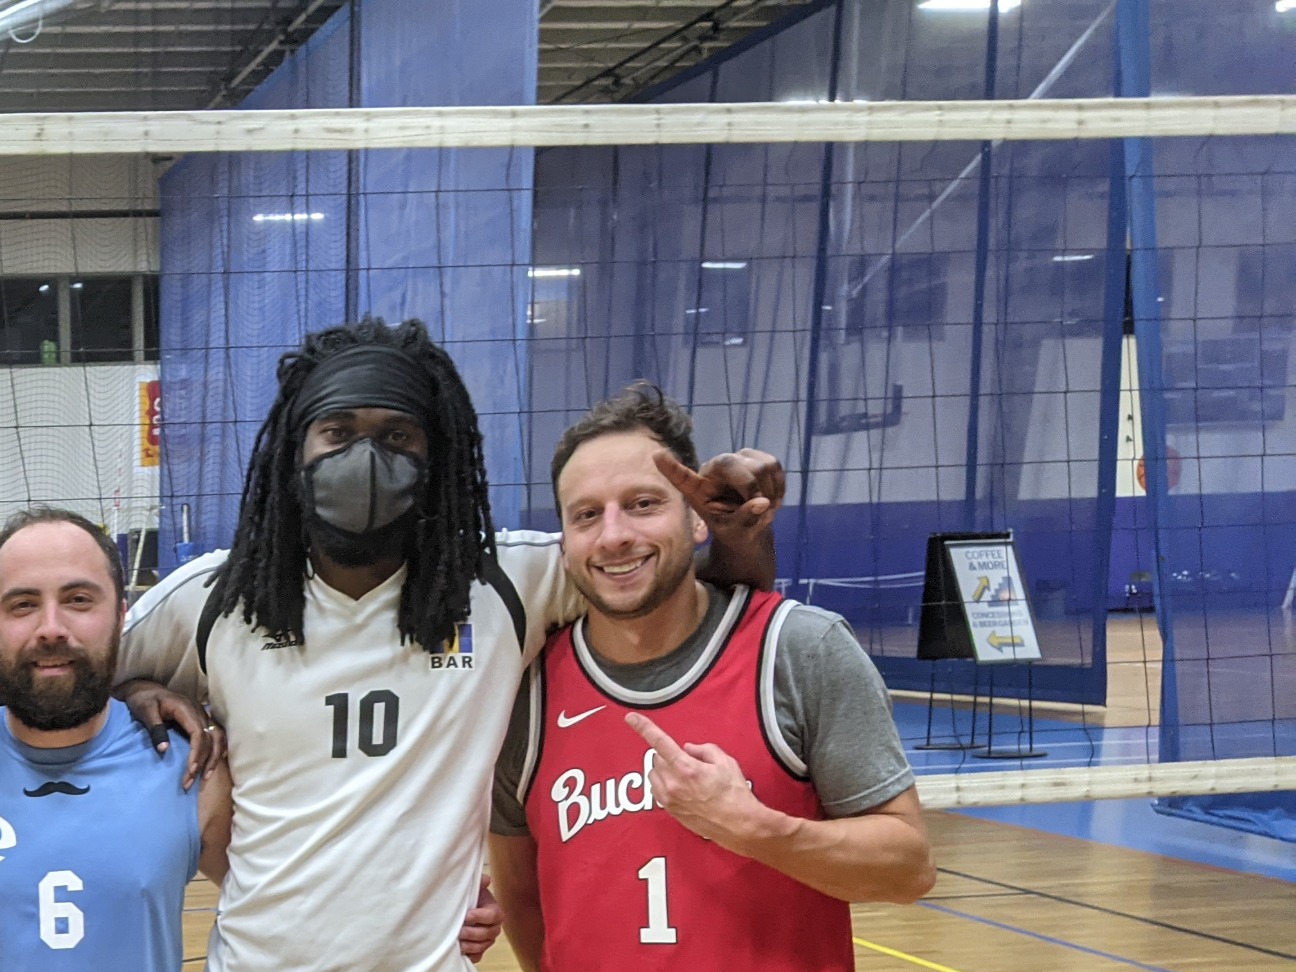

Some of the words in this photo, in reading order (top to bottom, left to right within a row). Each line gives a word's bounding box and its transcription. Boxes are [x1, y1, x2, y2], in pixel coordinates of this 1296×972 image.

[965, 550, 1004, 560] COFFEE
[978, 560, 1007, 571] MORE
[431, 655, 473, 669] BAR
[325, 689, 400, 759] 10
[38, 870, 85, 949] 6
[637, 856, 677, 944] 1
